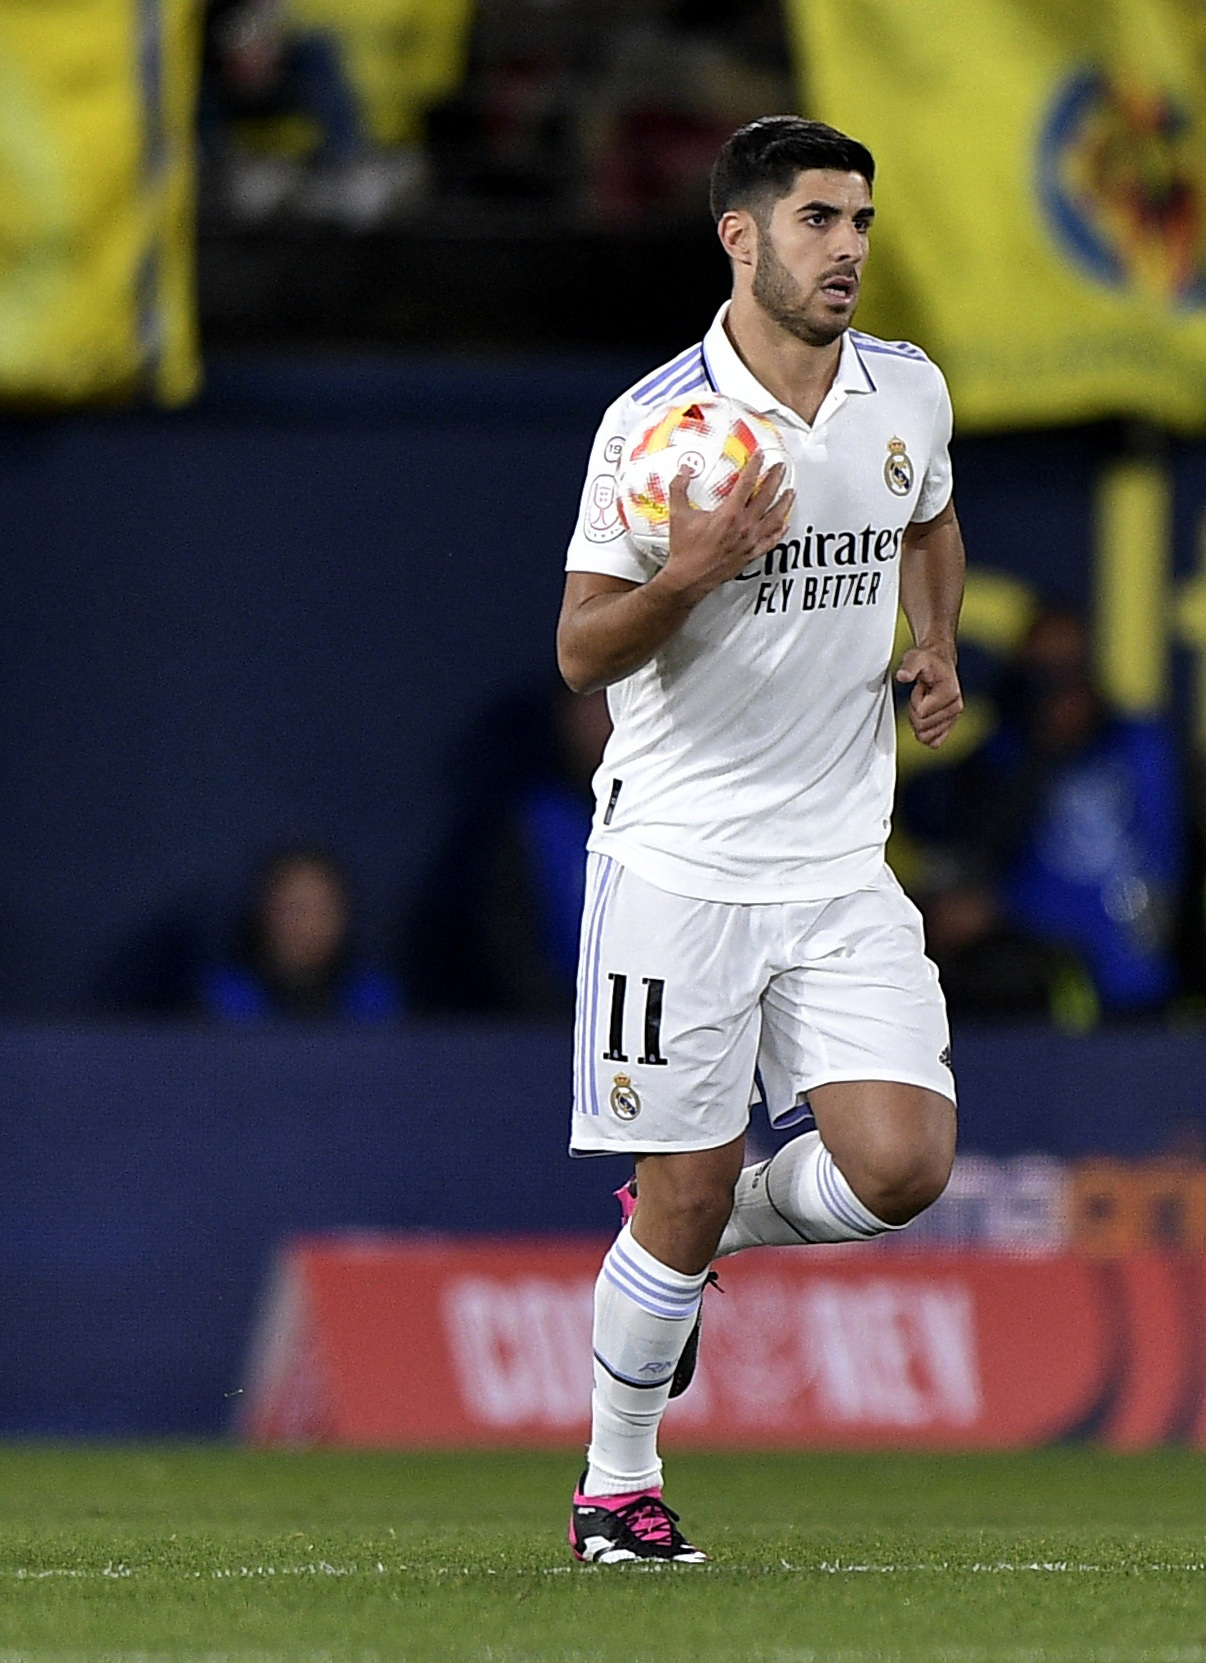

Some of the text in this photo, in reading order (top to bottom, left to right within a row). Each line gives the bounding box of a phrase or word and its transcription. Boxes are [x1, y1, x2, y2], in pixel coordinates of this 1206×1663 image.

[754, 571, 882, 615] FLY BETTER
[603, 972, 668, 1066] 11
